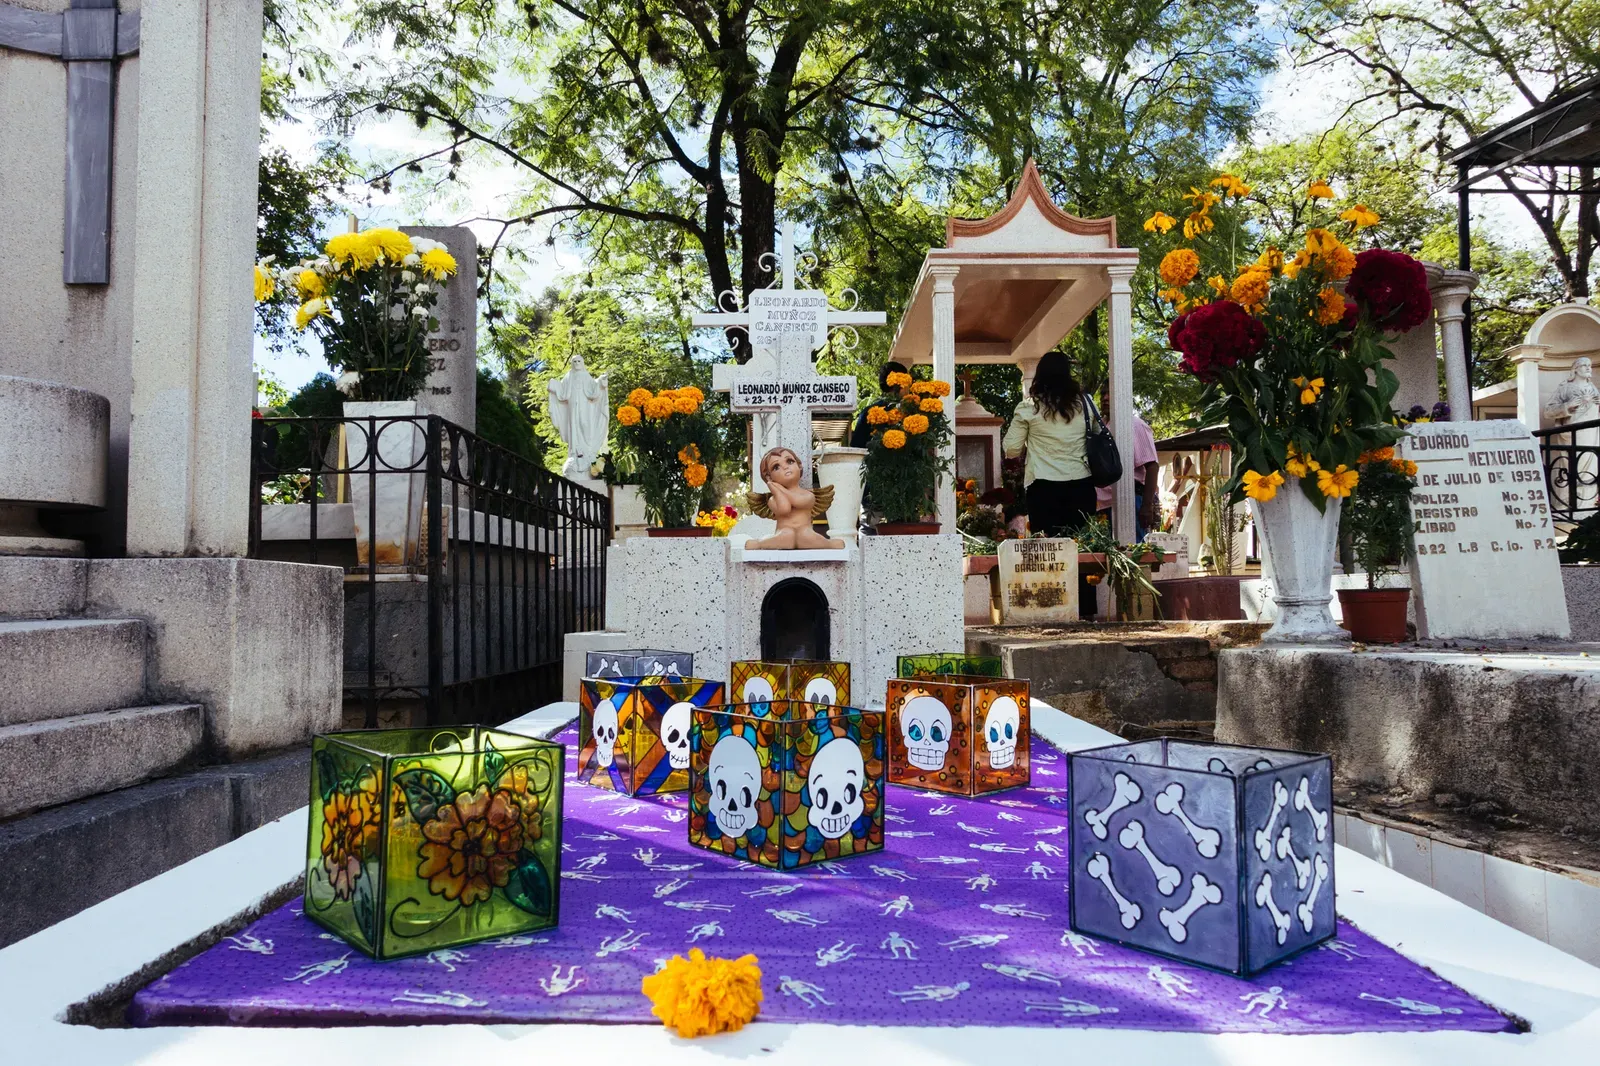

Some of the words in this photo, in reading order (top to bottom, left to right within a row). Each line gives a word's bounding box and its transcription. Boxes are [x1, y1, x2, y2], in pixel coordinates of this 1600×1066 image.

[754, 296, 827, 308] LEONARDO
[768, 309, 817, 321] MUÑOZ
[755, 321, 819, 333] CANSECO
[738, 383, 781, 395] LEONARDO
[782, 381, 811, 394] MUÑOZ
[812, 382, 850, 394] CANSECO
[1410, 434, 1470, 451] EDUARDO
[1468, 449, 1536, 467] MEIXUEIRO
[1422, 474, 1440, 486] DE
[1444, 472, 1482, 486] JULIO
[1487, 471, 1505, 484] DE
[1510, 470, 1542, 482] 1952
[1527, 489, 1545, 501] 32
[1414, 506, 1479, 520] REGISTRO
[1529, 503, 1548, 515] 75
[1416, 521, 1457, 534] LIBRO
[1540, 517, 1549, 529] 7
[1014, 542, 1064, 552] DISPONIBLE
[1022, 552, 1056, 562] FAMILIA
